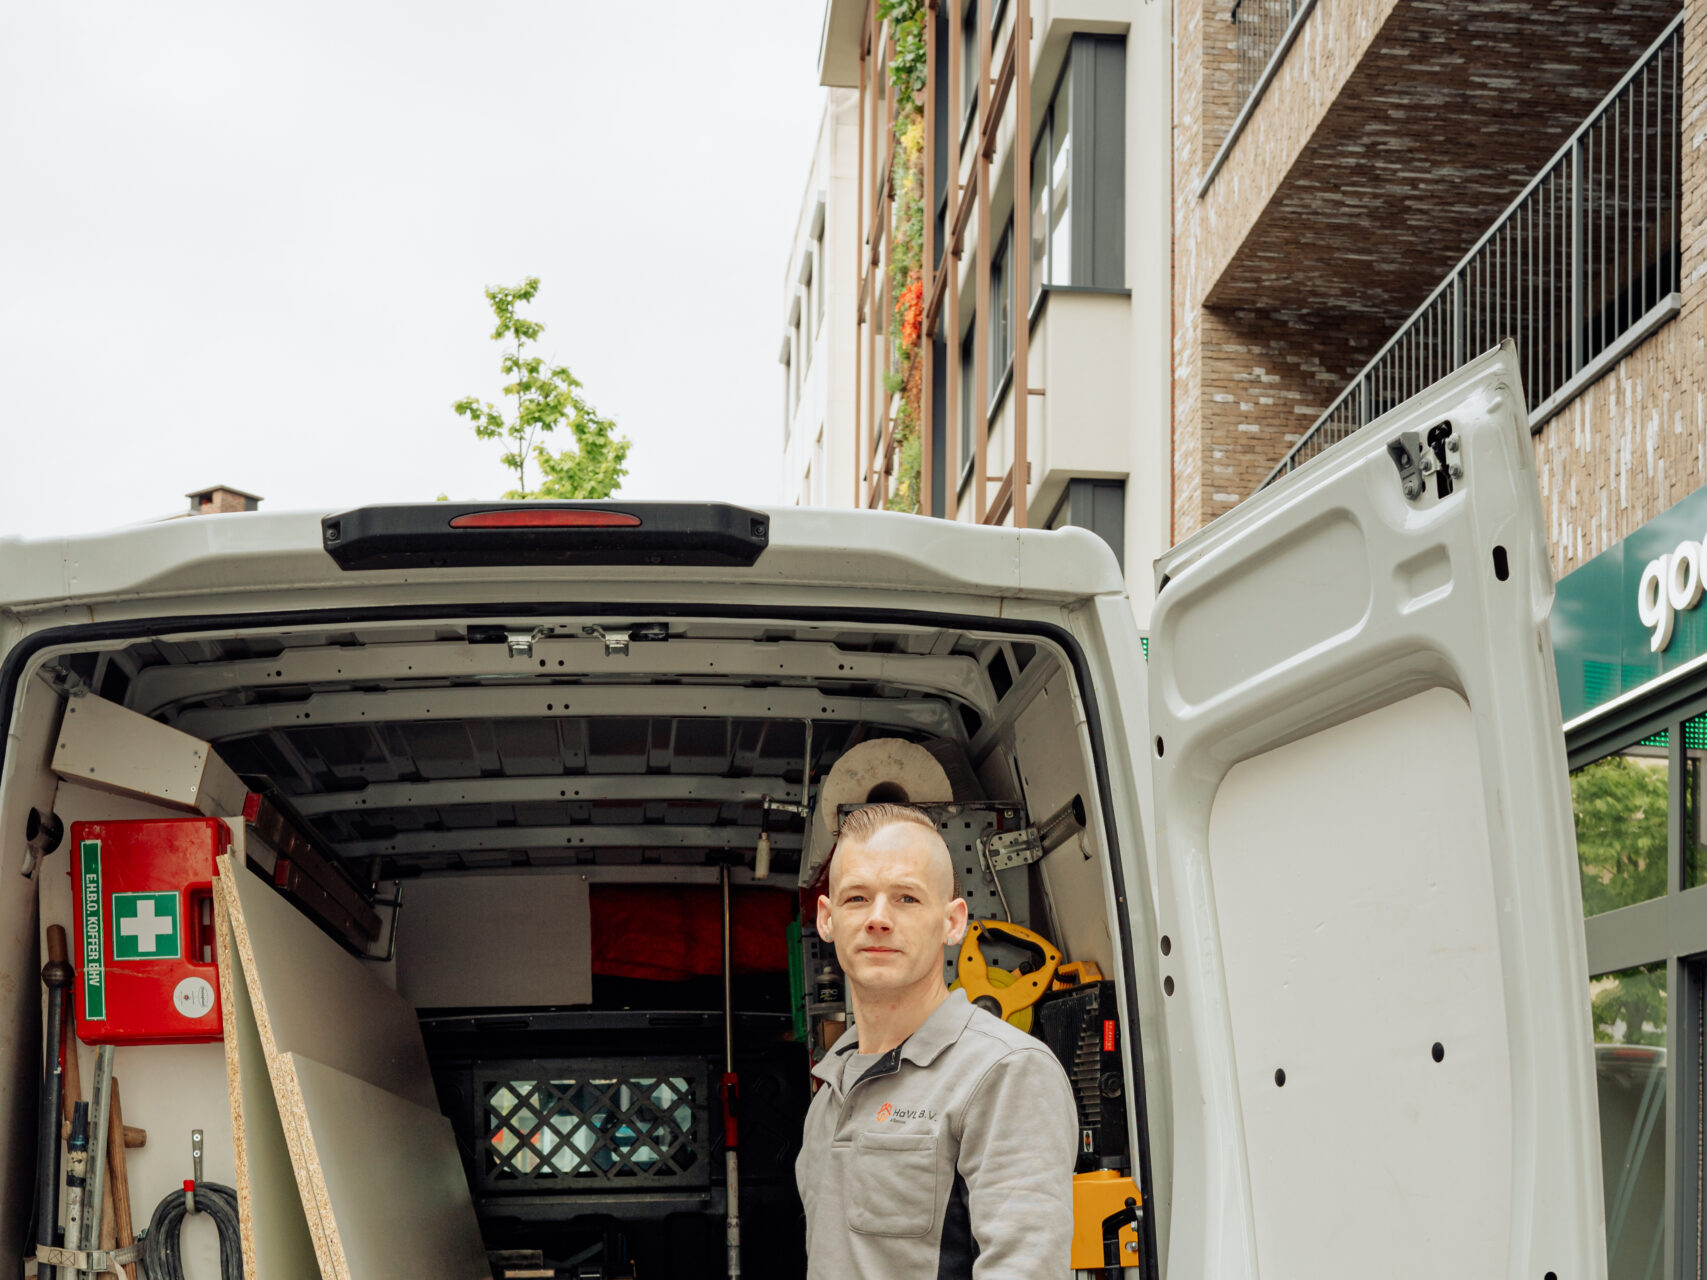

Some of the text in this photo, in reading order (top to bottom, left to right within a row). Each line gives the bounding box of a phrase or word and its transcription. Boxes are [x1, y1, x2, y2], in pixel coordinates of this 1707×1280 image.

[1638, 532, 1707, 653] go
[86, 873, 100, 986] E.H.B.O. KOFFER BHV
